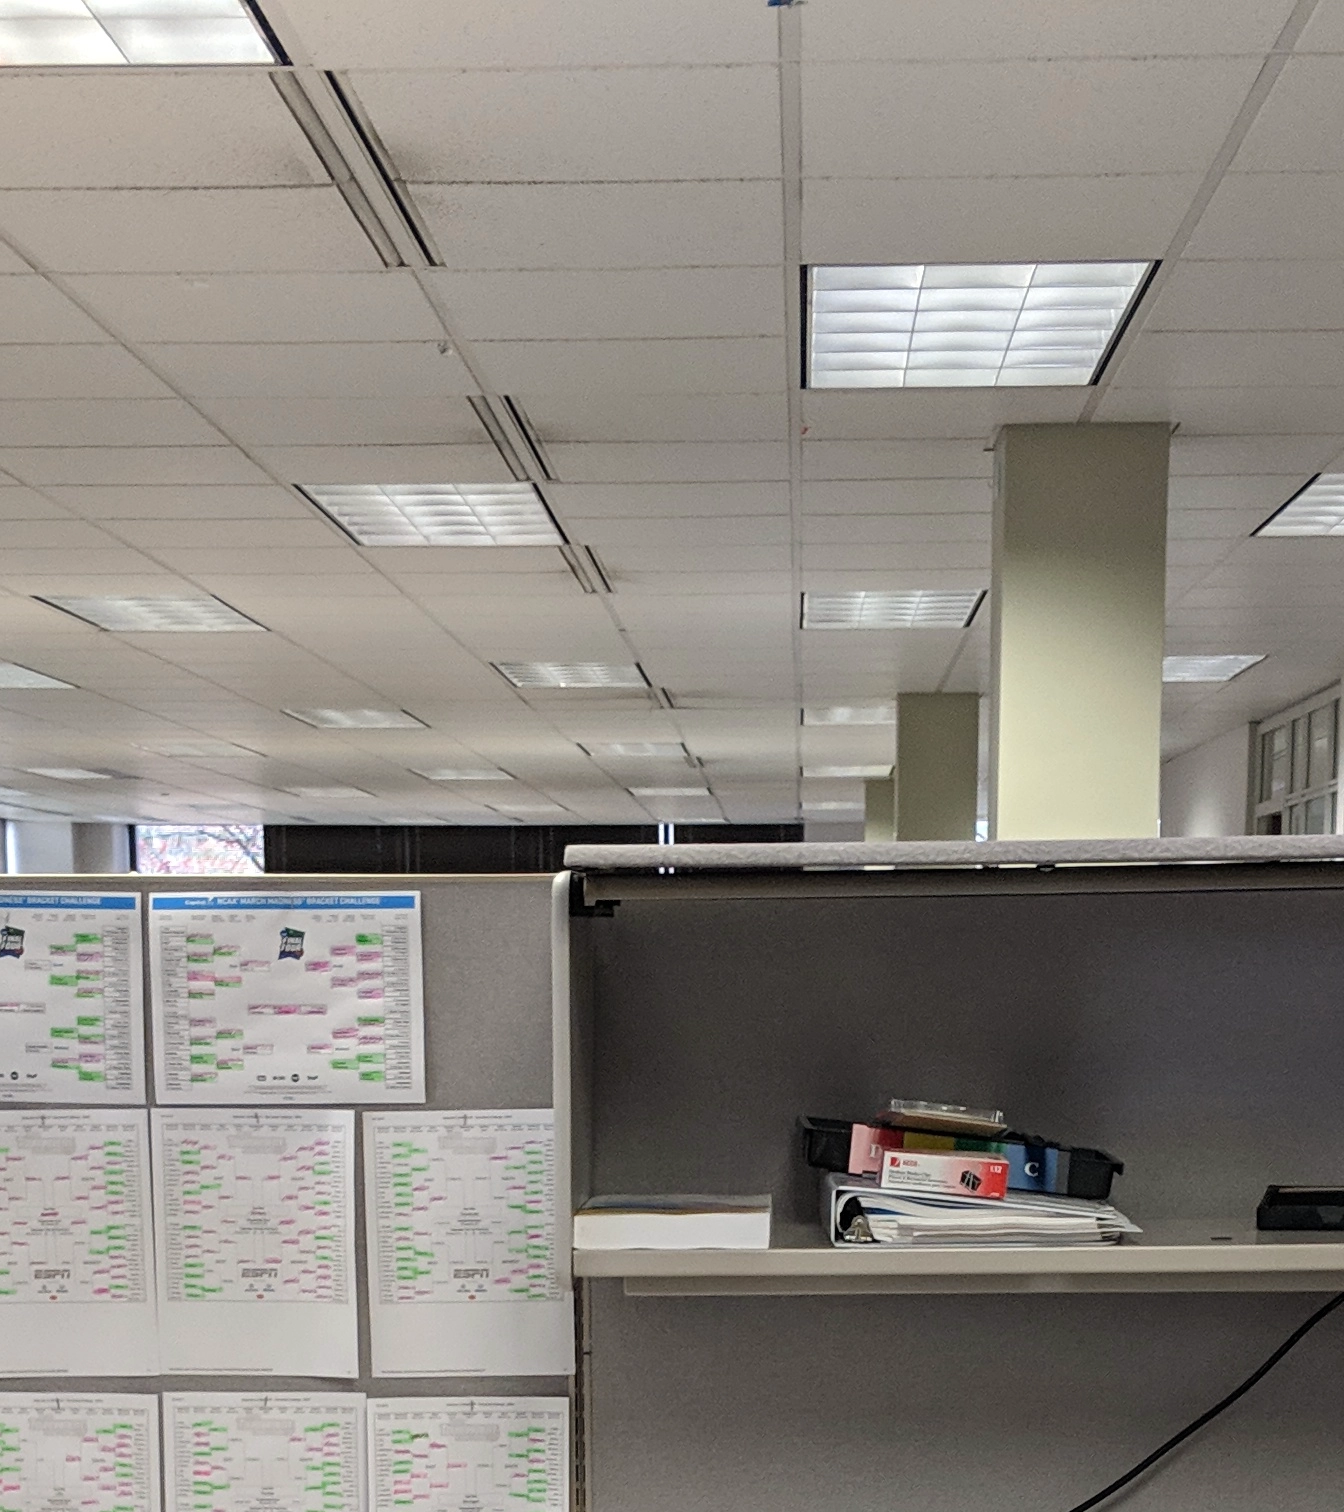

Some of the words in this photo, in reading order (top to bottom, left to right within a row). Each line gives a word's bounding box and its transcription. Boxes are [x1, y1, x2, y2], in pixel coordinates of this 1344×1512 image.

[27, 896, 60, 906] BRACKET
[60, 897, 101, 906] CHALLENGE
[239, 897, 267, 905] MARCH
[306, 897, 339, 906] BRACKET
[339, 897, 381, 906] CHALLENGE
[1024, 1162, 1039, 1177] C
[34, 1269, 71, 1279] ESPN
[241, 1268, 278, 1278] ESPN
[453, 1268, 490, 1279] ESPN
